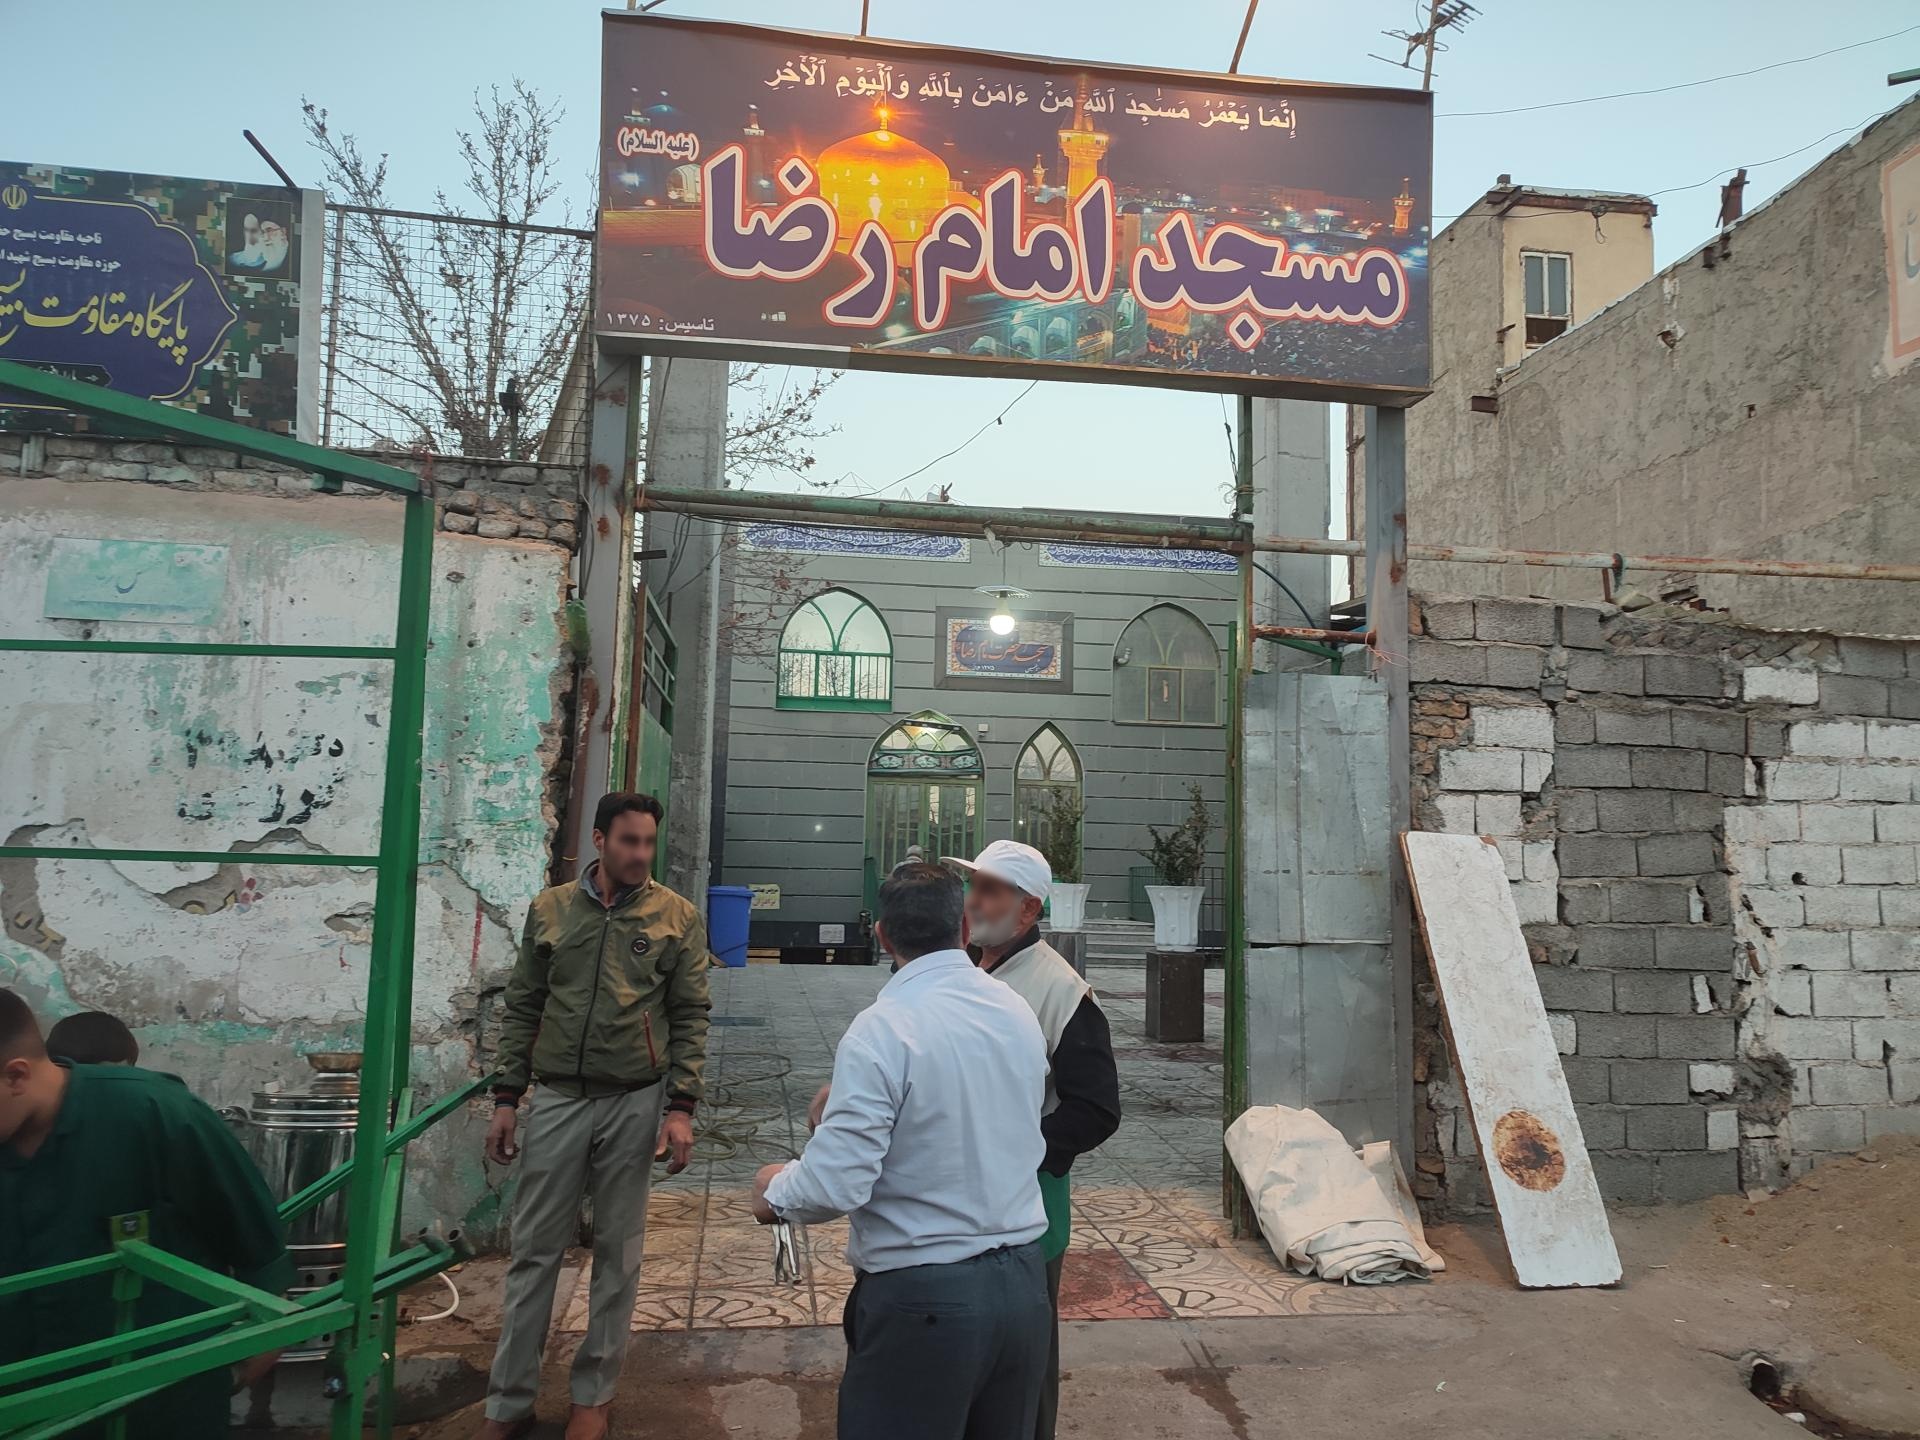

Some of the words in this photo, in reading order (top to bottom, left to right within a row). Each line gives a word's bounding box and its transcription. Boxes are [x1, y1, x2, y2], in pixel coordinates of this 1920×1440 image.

[704, 143, 899, 330] رضا
[914, 167, 1114, 332] امام
[1133, 209, 1407, 352] مسجد
[22, 291, 134, 335] مقاومت
[130, 277, 194, 366] پایگاه
[606, 312, 651, 327] ۱۳۷۵
